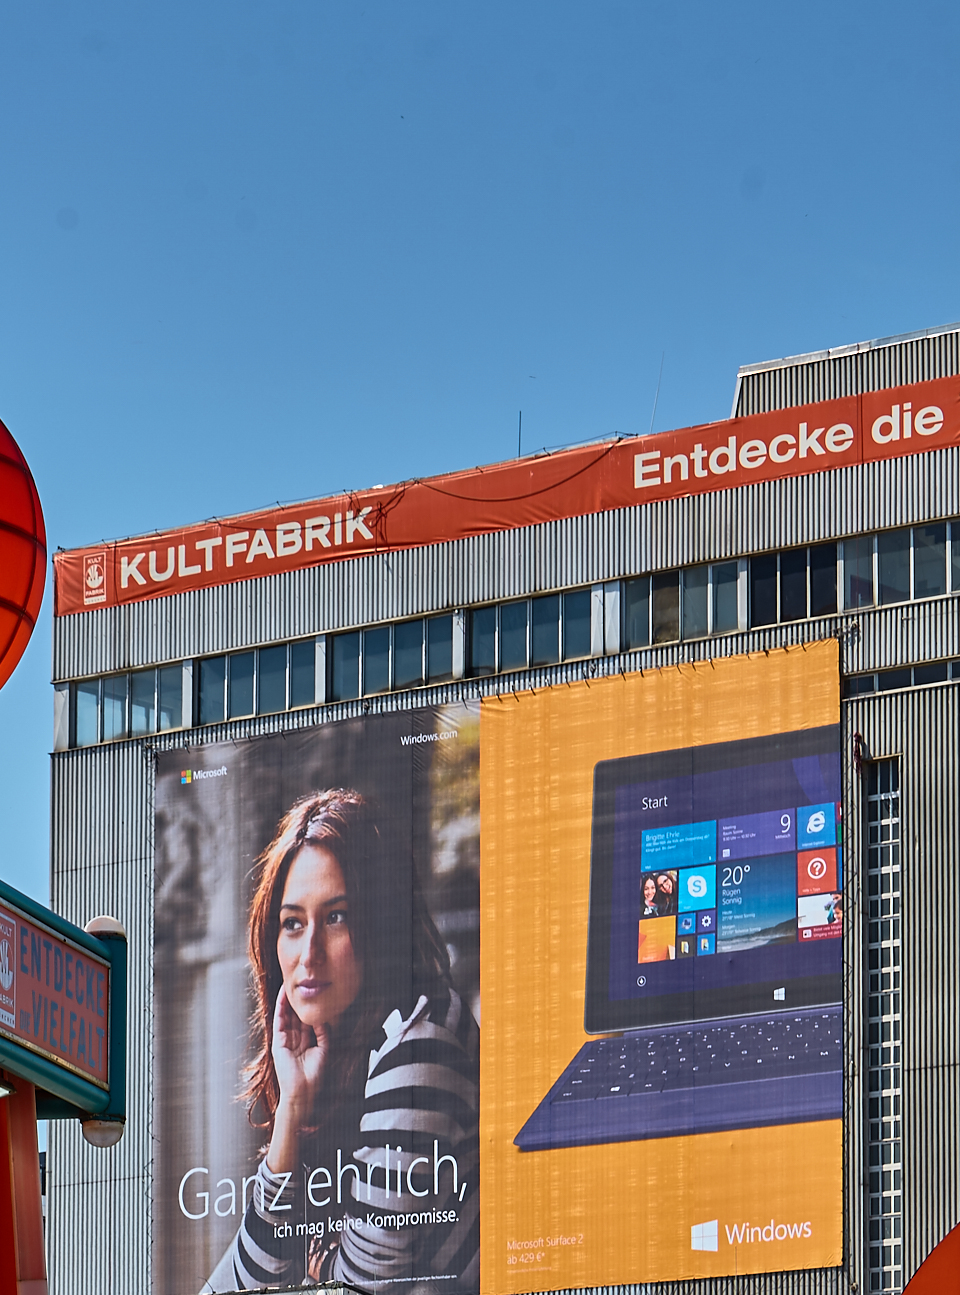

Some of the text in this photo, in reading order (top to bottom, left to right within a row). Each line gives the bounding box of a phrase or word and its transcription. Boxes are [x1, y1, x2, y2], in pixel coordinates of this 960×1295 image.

[634, 402, 944, 489] Entdecke die
[120, 506, 374, 589] KULTFABRIK
[400, 729, 458, 747] Windows.com
[193, 765, 227, 780] Microsoft
[641, 795, 668, 811] Start
[780, 814, 791, 833] 9
[722, 864, 751, 887] 20°
[722, 888, 741, 898] Rügen
[722, 897, 742, 905] Sonnig
[0, 923, 13, 937] KULT
[20, 925, 105, 1018] ENTDECKE
[20, 990, 105, 1072] DIE VIELFALT
[179, 1139, 467, 1220] Ganz ehrlich,
[273, 1209, 460, 1239] ich mag keine Kompromisse.
[725, 1219, 812, 1246] Windows
[507, 1233, 584, 1251] Microsoft Surface 2
[507, 1253, 535, 1265] ab 429
